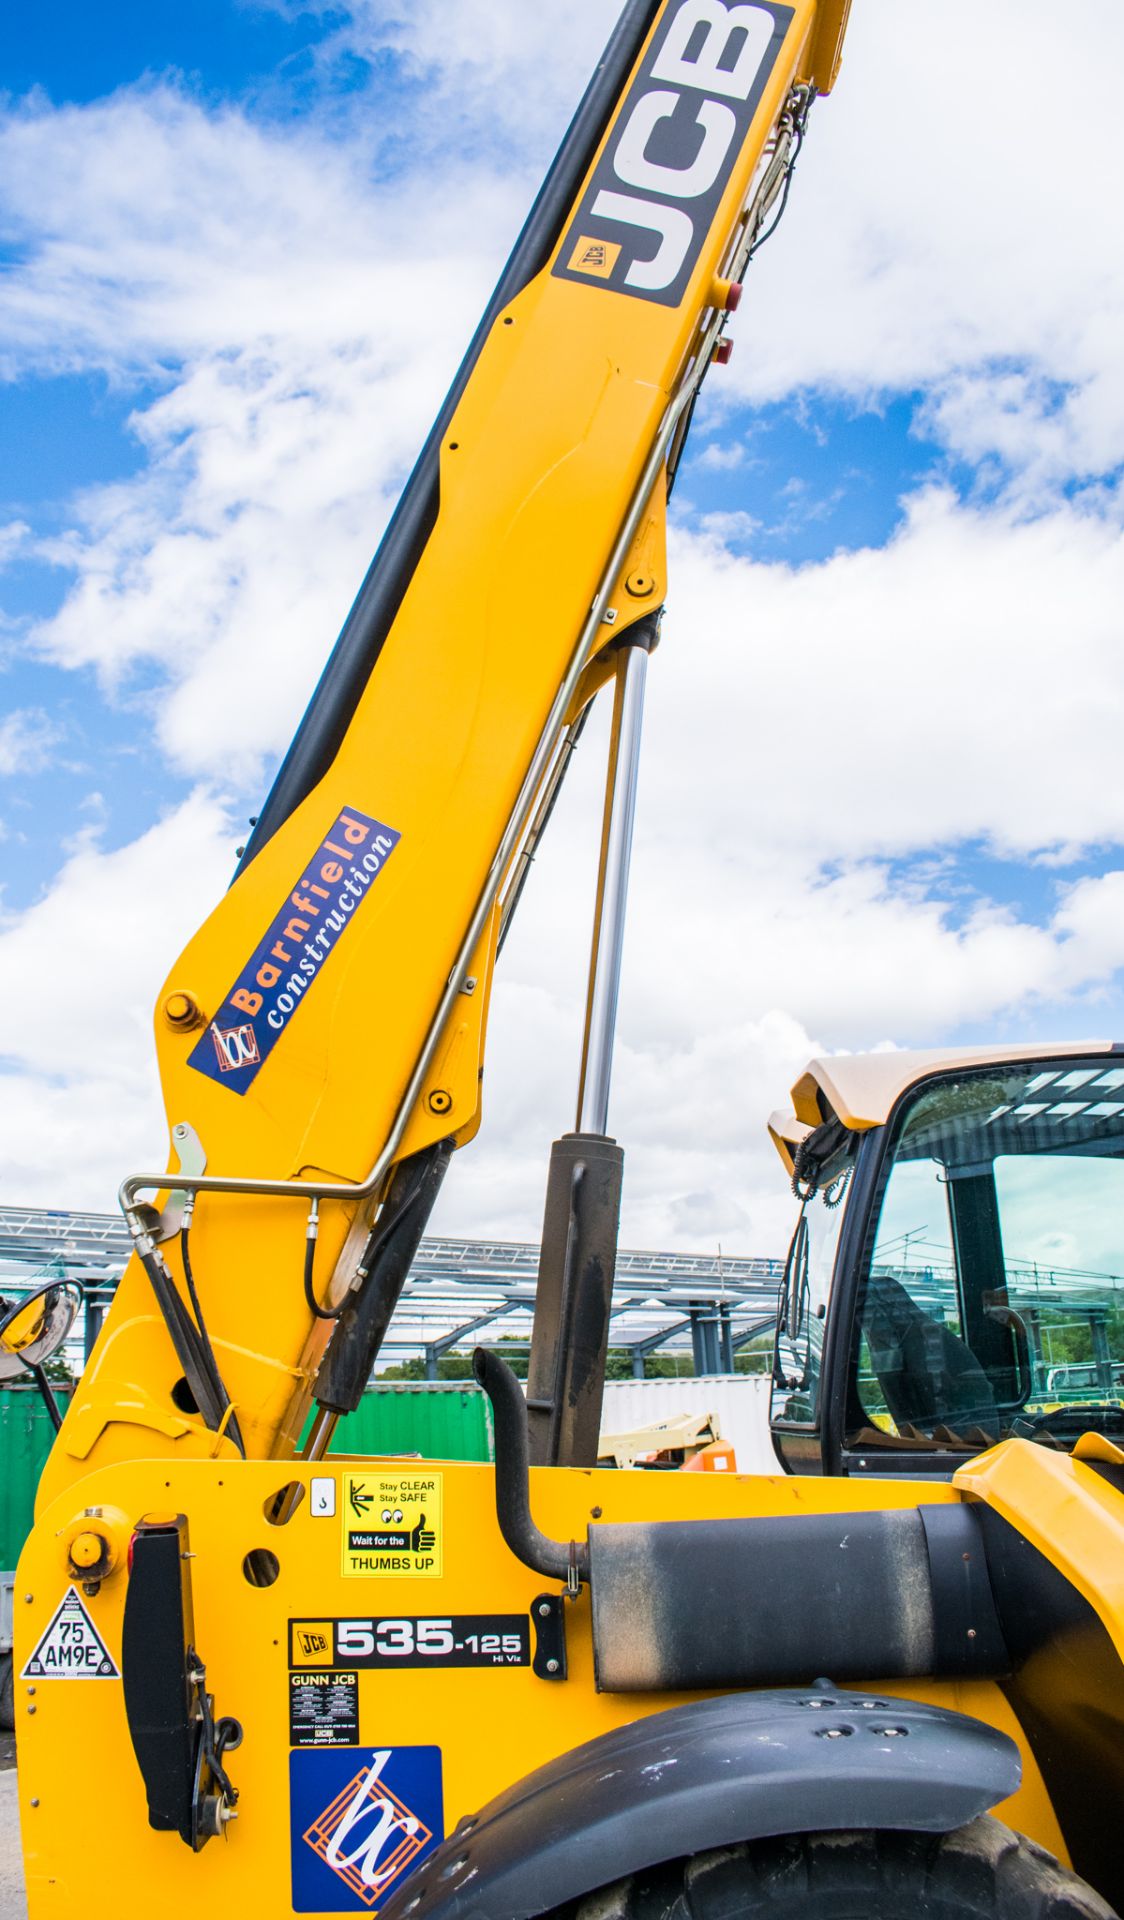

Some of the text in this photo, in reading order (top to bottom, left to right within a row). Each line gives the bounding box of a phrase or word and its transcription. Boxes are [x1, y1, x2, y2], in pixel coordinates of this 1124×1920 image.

[590, 0, 776, 290] JCB
[582, 247, 603, 265] JCB
[230, 814, 370, 1017] Barnfield
[267, 834, 392, 1029] construction
[379, 1481, 435, 1492] Stay CLEAR
[379, 1493, 427, 1503] Stay SAFE
[352, 1535, 405, 1545] Wait for the
[350, 1557, 434, 1570] THUMBS UP
[59, 1622, 84, 1644] 75
[337, 1620, 522, 1656] 535-125
[302, 1634, 327, 1654] JCB
[45, 1645, 98, 1667] AM9E
[493, 1655, 503, 1663] Hi
[291, 1674, 356, 1686] GUNN JCB
